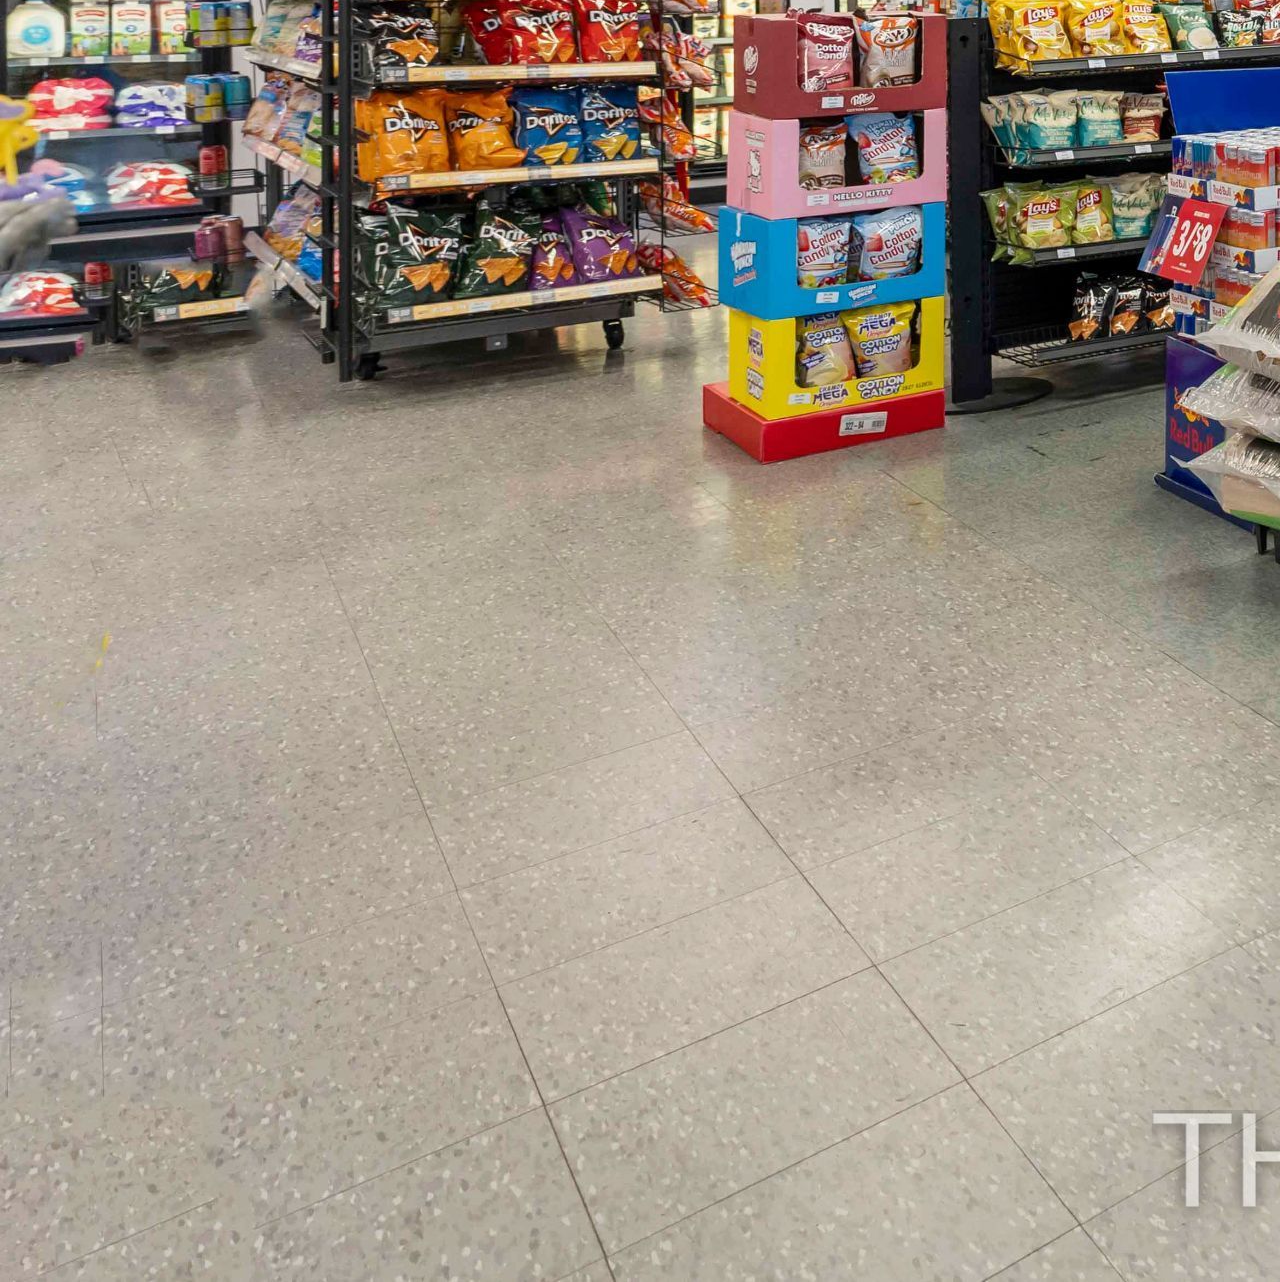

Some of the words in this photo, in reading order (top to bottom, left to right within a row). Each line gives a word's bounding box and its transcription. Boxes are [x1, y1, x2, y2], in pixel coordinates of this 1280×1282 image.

[1027, 4, 1057, 22] Lay's
[1085, 4, 1115, 25] Lay's
[526, 113, 578, 126] Doritos
[584, 106, 638, 120] Doritos
[385, 117, 439, 131] Doritos
[871, 127, 906, 146] Cotton
[862, 141, 895, 162] Candy
[833, 191, 863, 201] HELLO
[865, 188, 893, 197] KITTY
[1023, 199, 1058, 217] Lay's
[399, 231, 460, 248] Doritos
[810, 229, 844, 250] Cotton
[884, 226, 918, 249] Cotton
[797, 246, 830, 267] Candy
[869, 243, 905, 265] Candy
[859, 317, 897, 335] MEGA
[813, 335, 845, 348] CANDY
[860, 334, 901, 350] COTTON
[864, 342, 898, 357] CANDY
[857, 374, 905, 392] COTTON
[861, 384, 901, 399] CANDY
[813, 388, 848, 405] MEGA
[1170, 419, 1188, 448] Red
